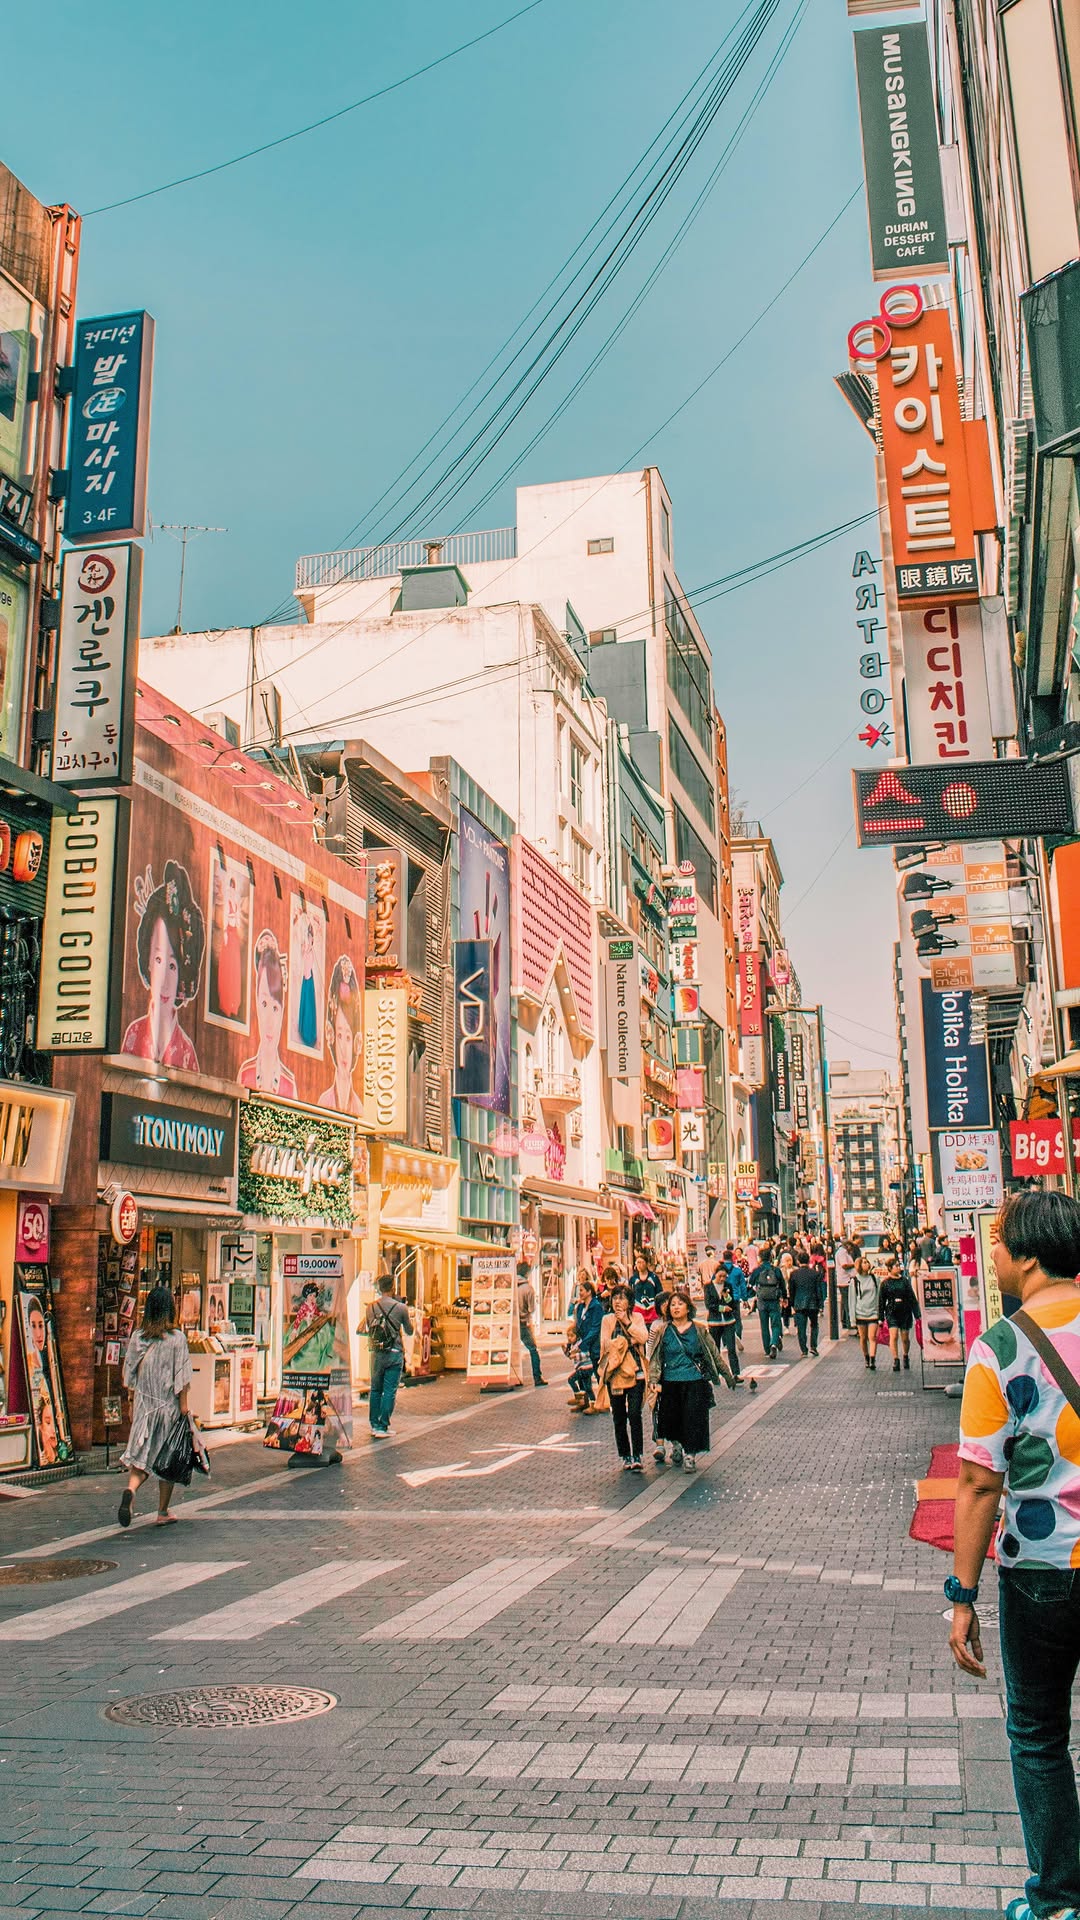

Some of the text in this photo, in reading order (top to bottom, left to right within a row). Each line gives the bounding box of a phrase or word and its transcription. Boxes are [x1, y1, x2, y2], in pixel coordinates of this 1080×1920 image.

[884, 232, 936, 247] DESSERT
[885, 221, 929, 235] DURIAN
[896, 245, 925, 257] CAFE
[84, 325, 136, 350] 컨디션
[890, 343, 956, 552] 카이스트
[900, 563, 974, 589] 眼鏡院
[70, 596, 115, 717] 겐로쿠
[923, 606, 970, 758] 디디치킨
[56, 751, 117, 770] 꼬치구이
[56, 810, 99, 1022] GOBDI GOUN
[669, 900, 698, 913] Mud
[616, 963, 627, 1007] Nature
[935, 976, 970, 986] mall
[459, 966, 485, 1069] VDL
[743, 995, 753, 1010] 2
[617, 1010, 629, 1073] Collection
[377, 998, 398, 1126] SKINFOOD
[777, 1052, 786, 1111] HOLLYS COFFEE
[944, 1055, 968, 1124] Holika
[142, 1114, 224, 1158] TONYMOLY
[682, 1121, 699, 1142] 光
[1015, 1132, 1050, 1167] Big
[738, 1164, 755, 1174] BIG
